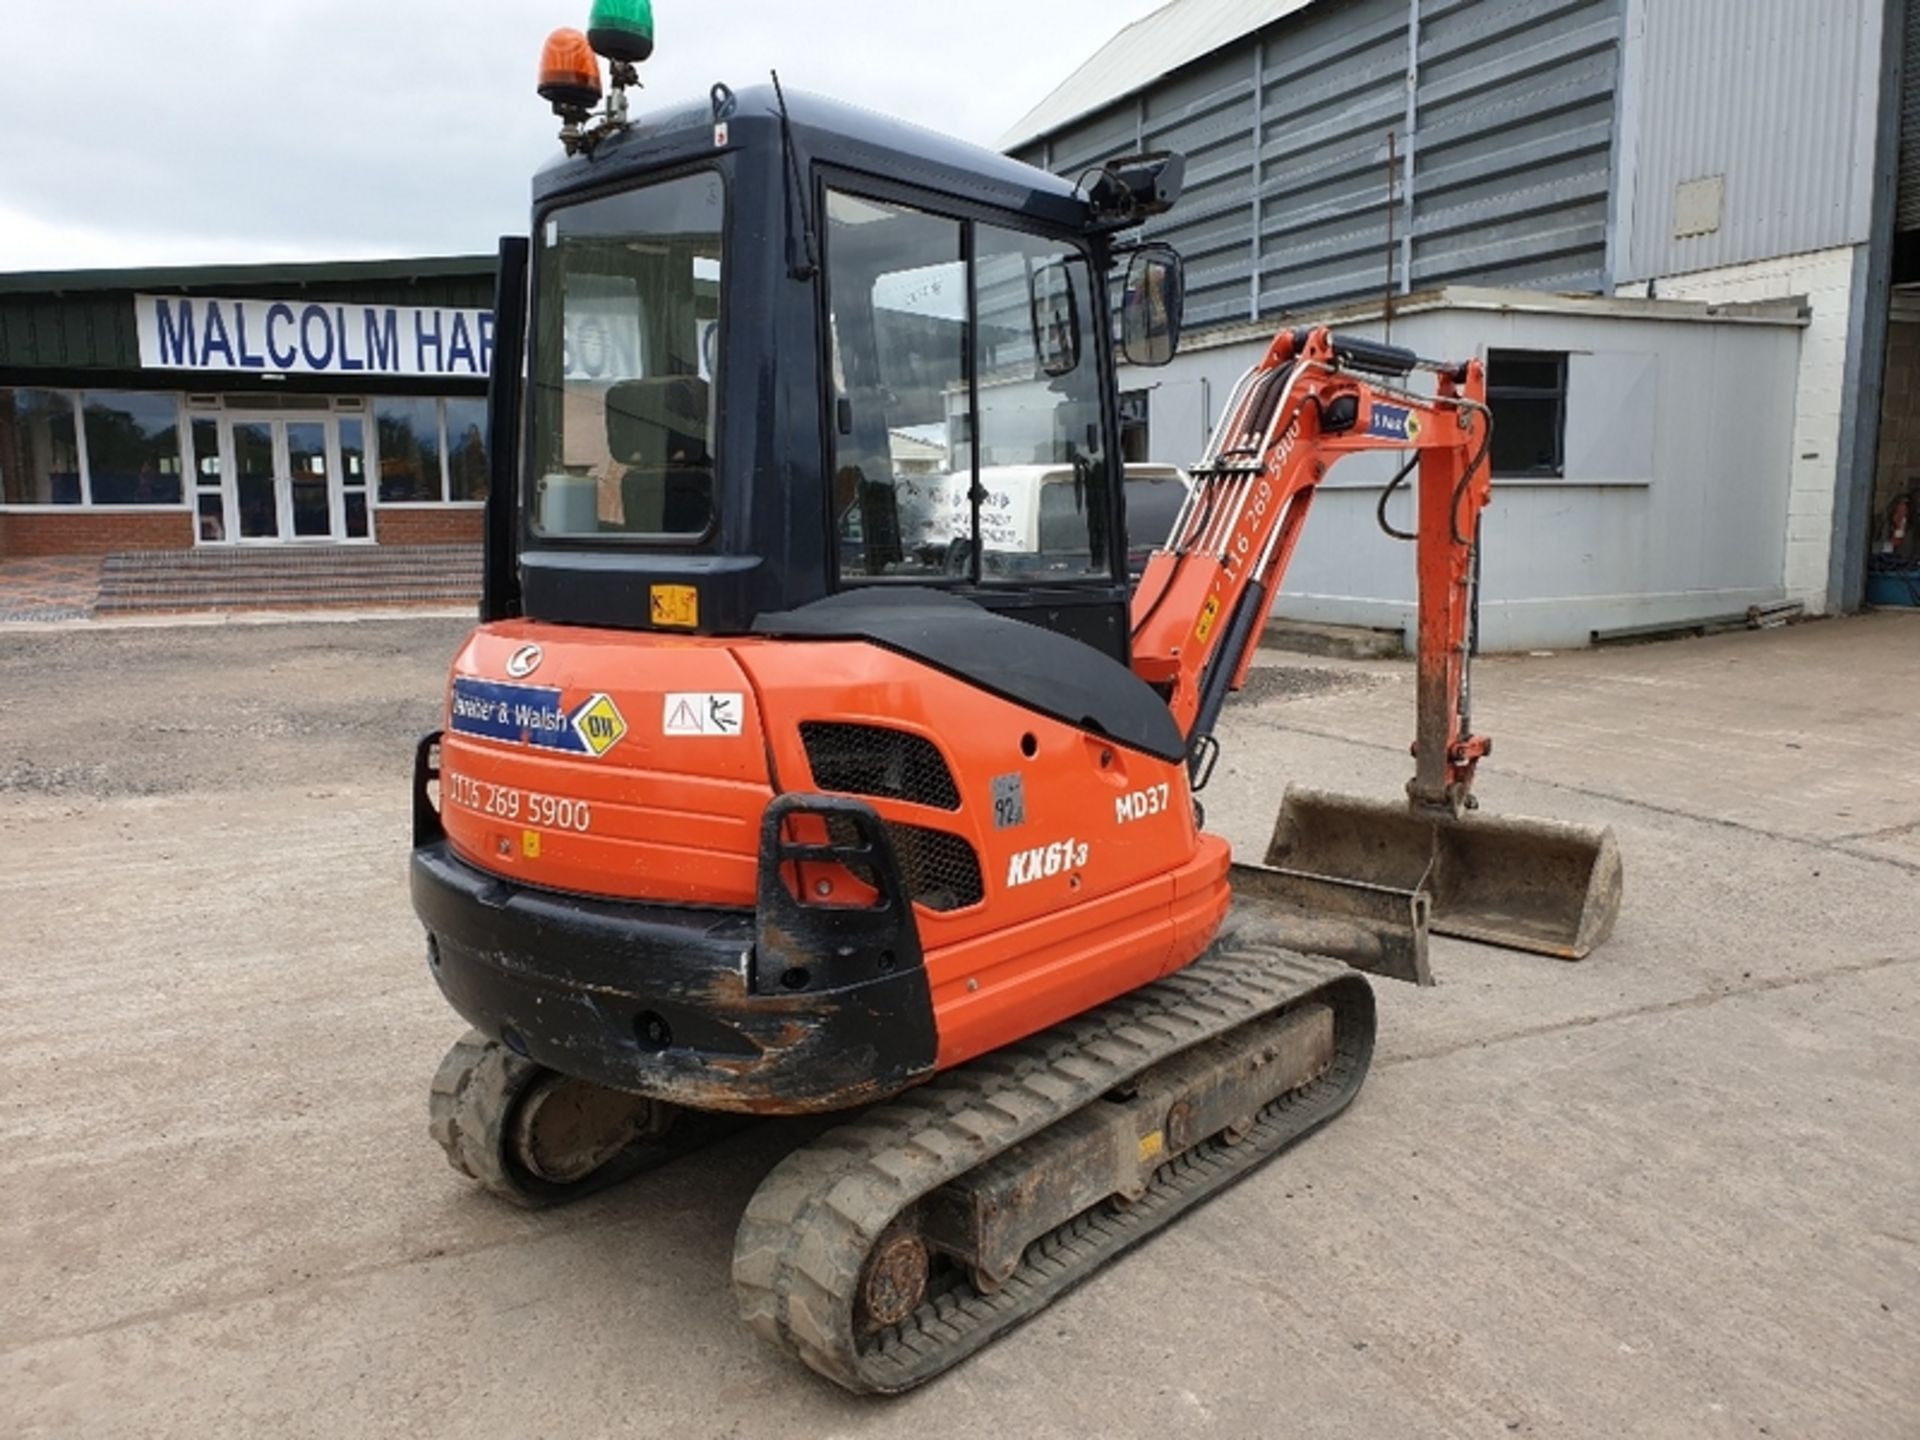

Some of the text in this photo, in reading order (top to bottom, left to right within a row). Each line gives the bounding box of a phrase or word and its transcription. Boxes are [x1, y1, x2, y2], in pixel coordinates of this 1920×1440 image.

[156, 300, 398, 371] MALCOLM
[1246, 482, 1273, 532] 269
[498, 702, 510, 725] &
[515, 704, 567, 732] Walsh
[485, 784, 519, 818] 269
[528, 794, 589, 831] 5900
[1115, 782, 1168, 824] MD37
